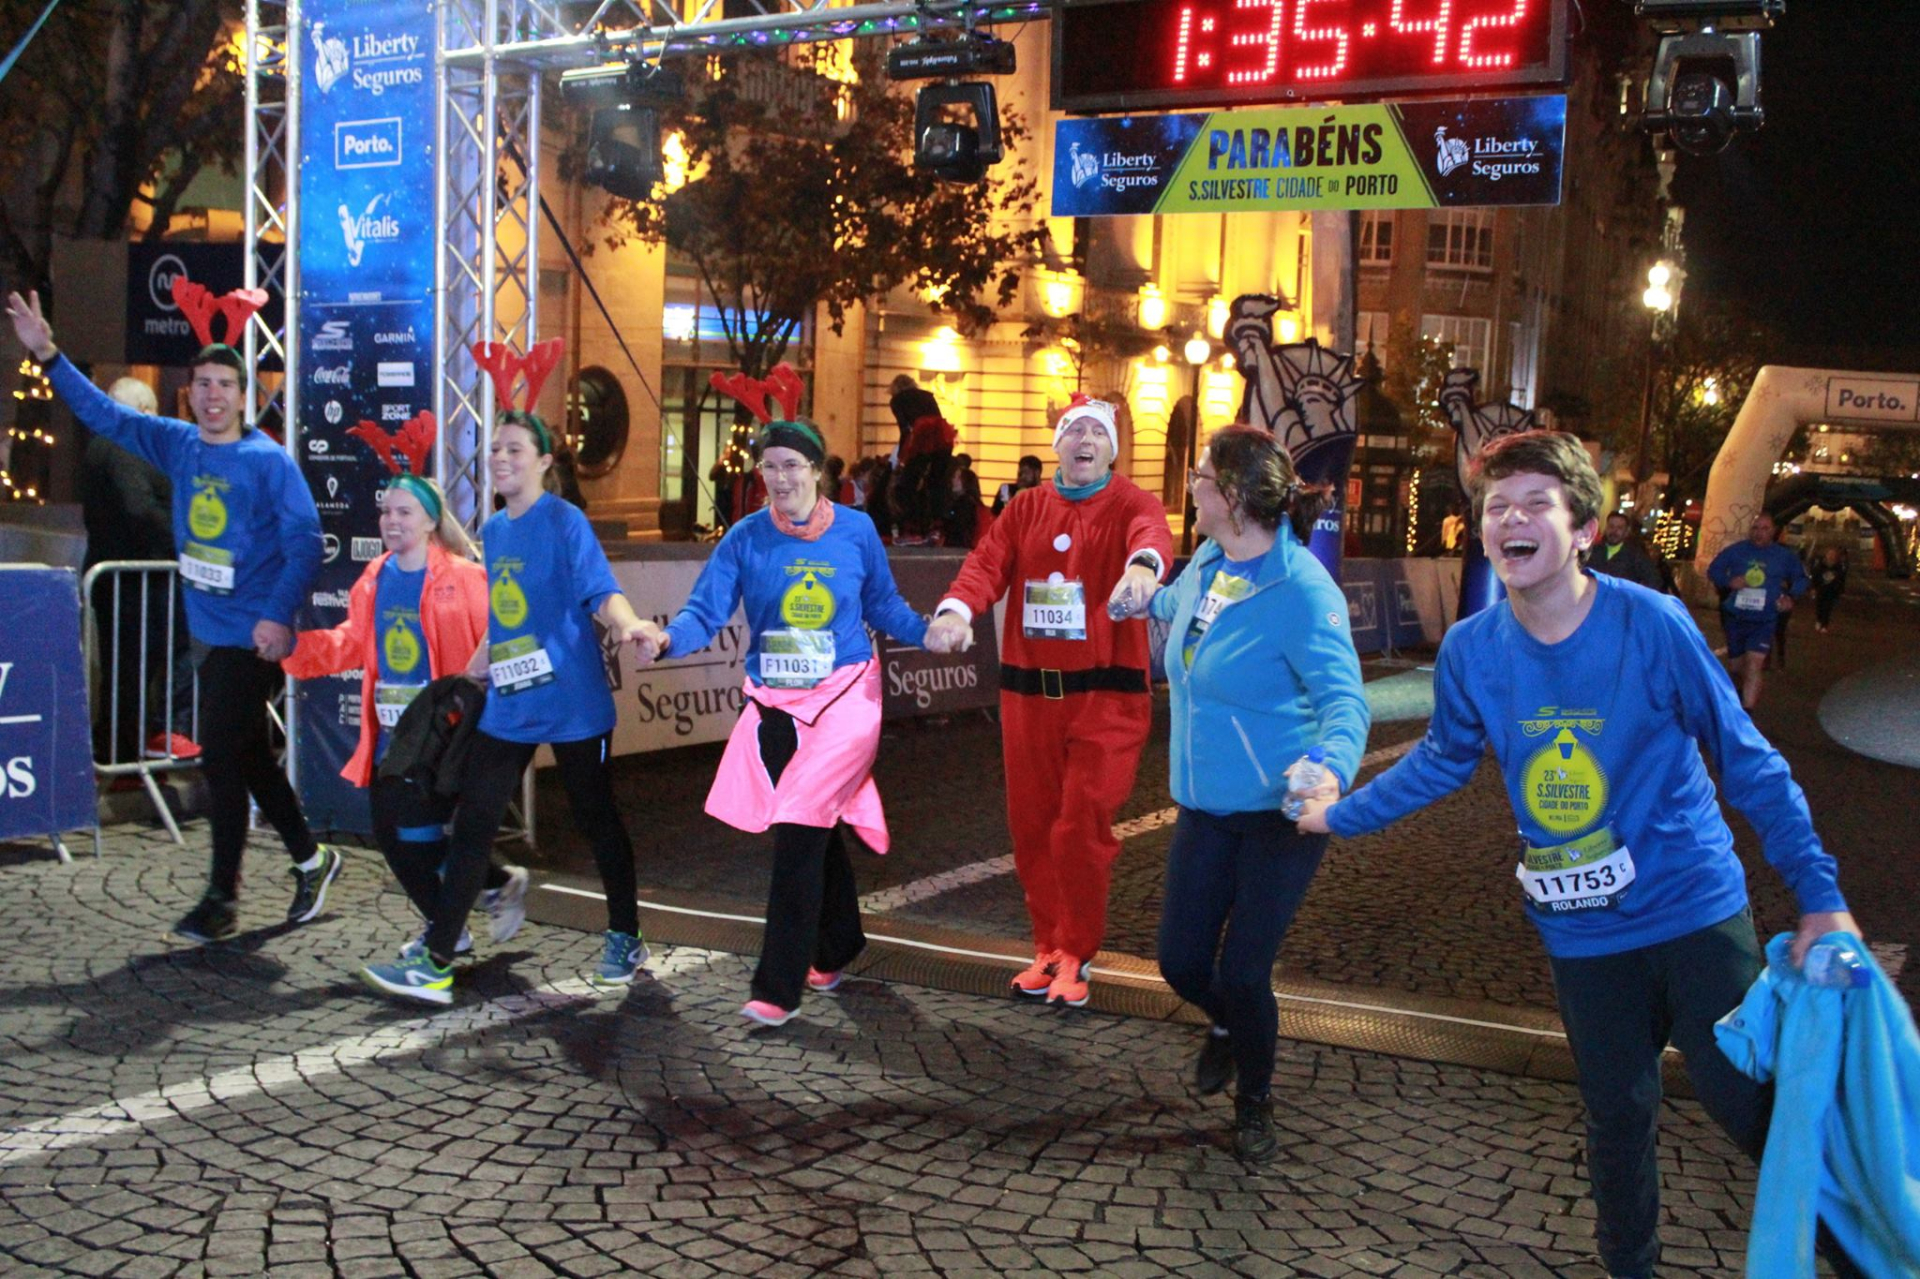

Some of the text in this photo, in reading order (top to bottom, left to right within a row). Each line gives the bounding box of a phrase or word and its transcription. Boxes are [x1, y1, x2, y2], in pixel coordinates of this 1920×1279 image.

[353, 33, 419, 61] Liberty
[353, 67, 422, 96] Seguros
[344, 134, 394, 156] Porto.
[1207, 115, 1384, 170] PARABÉNS
[1473, 137, 1539, 158] Liberty
[1103, 152, 1157, 171] Liberty
[1472, 160, 1540, 181] Seguros
[1101, 174, 1158, 192] Seguros
[1189, 174, 1398, 200] S.SILVESTRE CIDADE DO PORTO
[144, 318, 190, 336] metro
[373, 330, 416, 345] GARMIN
[1838, 388, 1907, 411] Porto.
[1033, 609, 1073, 624] 11034
[888, 660, 977, 709] Seguros
[1537, 783, 1591, 800] S.SILVESTRE
[1534, 865, 1617, 896] 11753
[1551, 896, 1609, 912] ROLANDO
